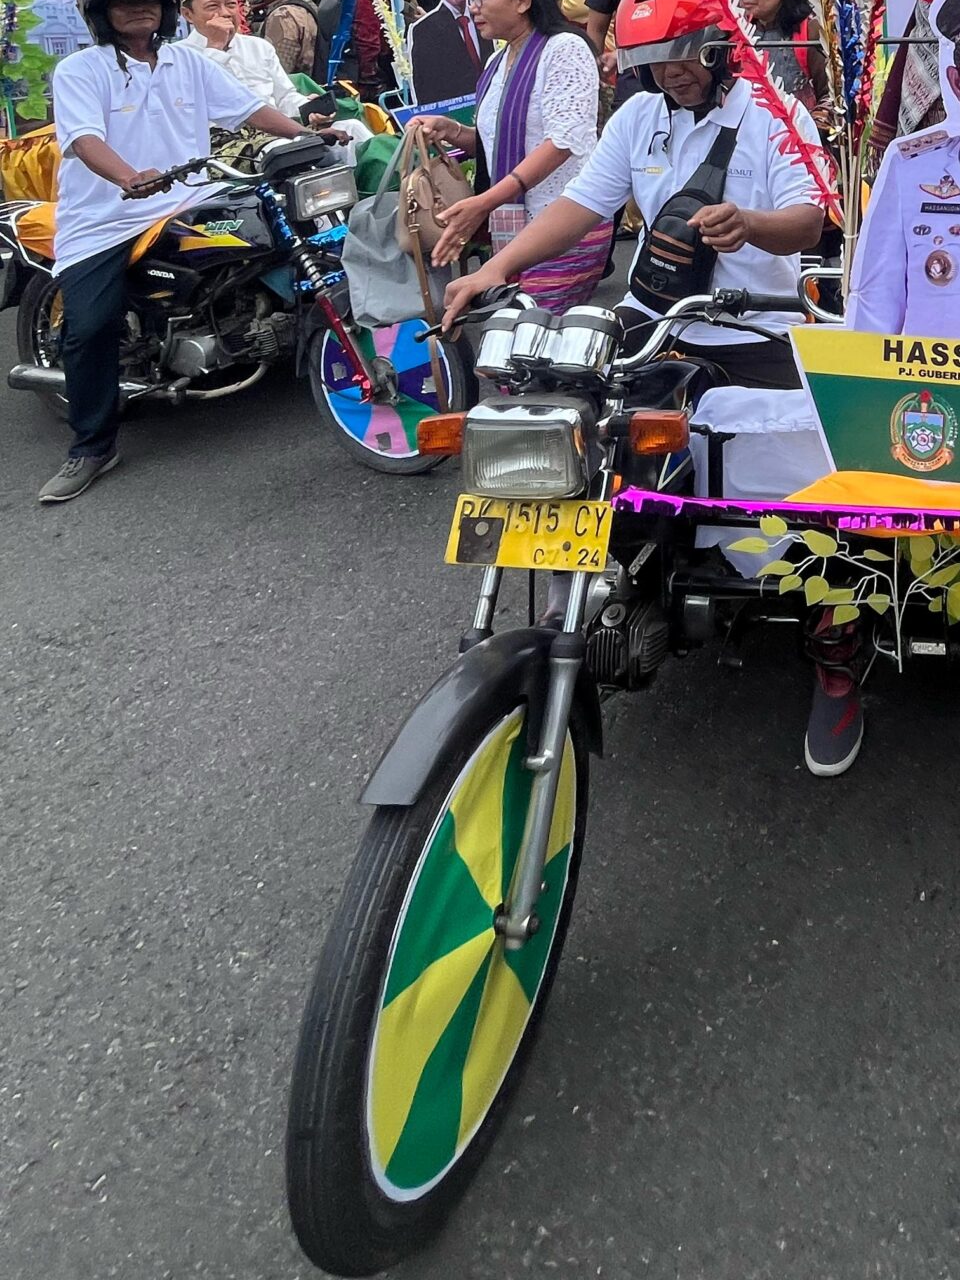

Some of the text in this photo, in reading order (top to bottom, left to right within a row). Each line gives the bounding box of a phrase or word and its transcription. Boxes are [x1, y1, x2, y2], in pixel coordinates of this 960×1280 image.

[205, 220, 243, 231] WIN
[899, 367, 915, 377] PJ.
[505, 501, 561, 534] 1515
[574, 505, 608, 537] CY
[577, 548, 600, 566] 24
